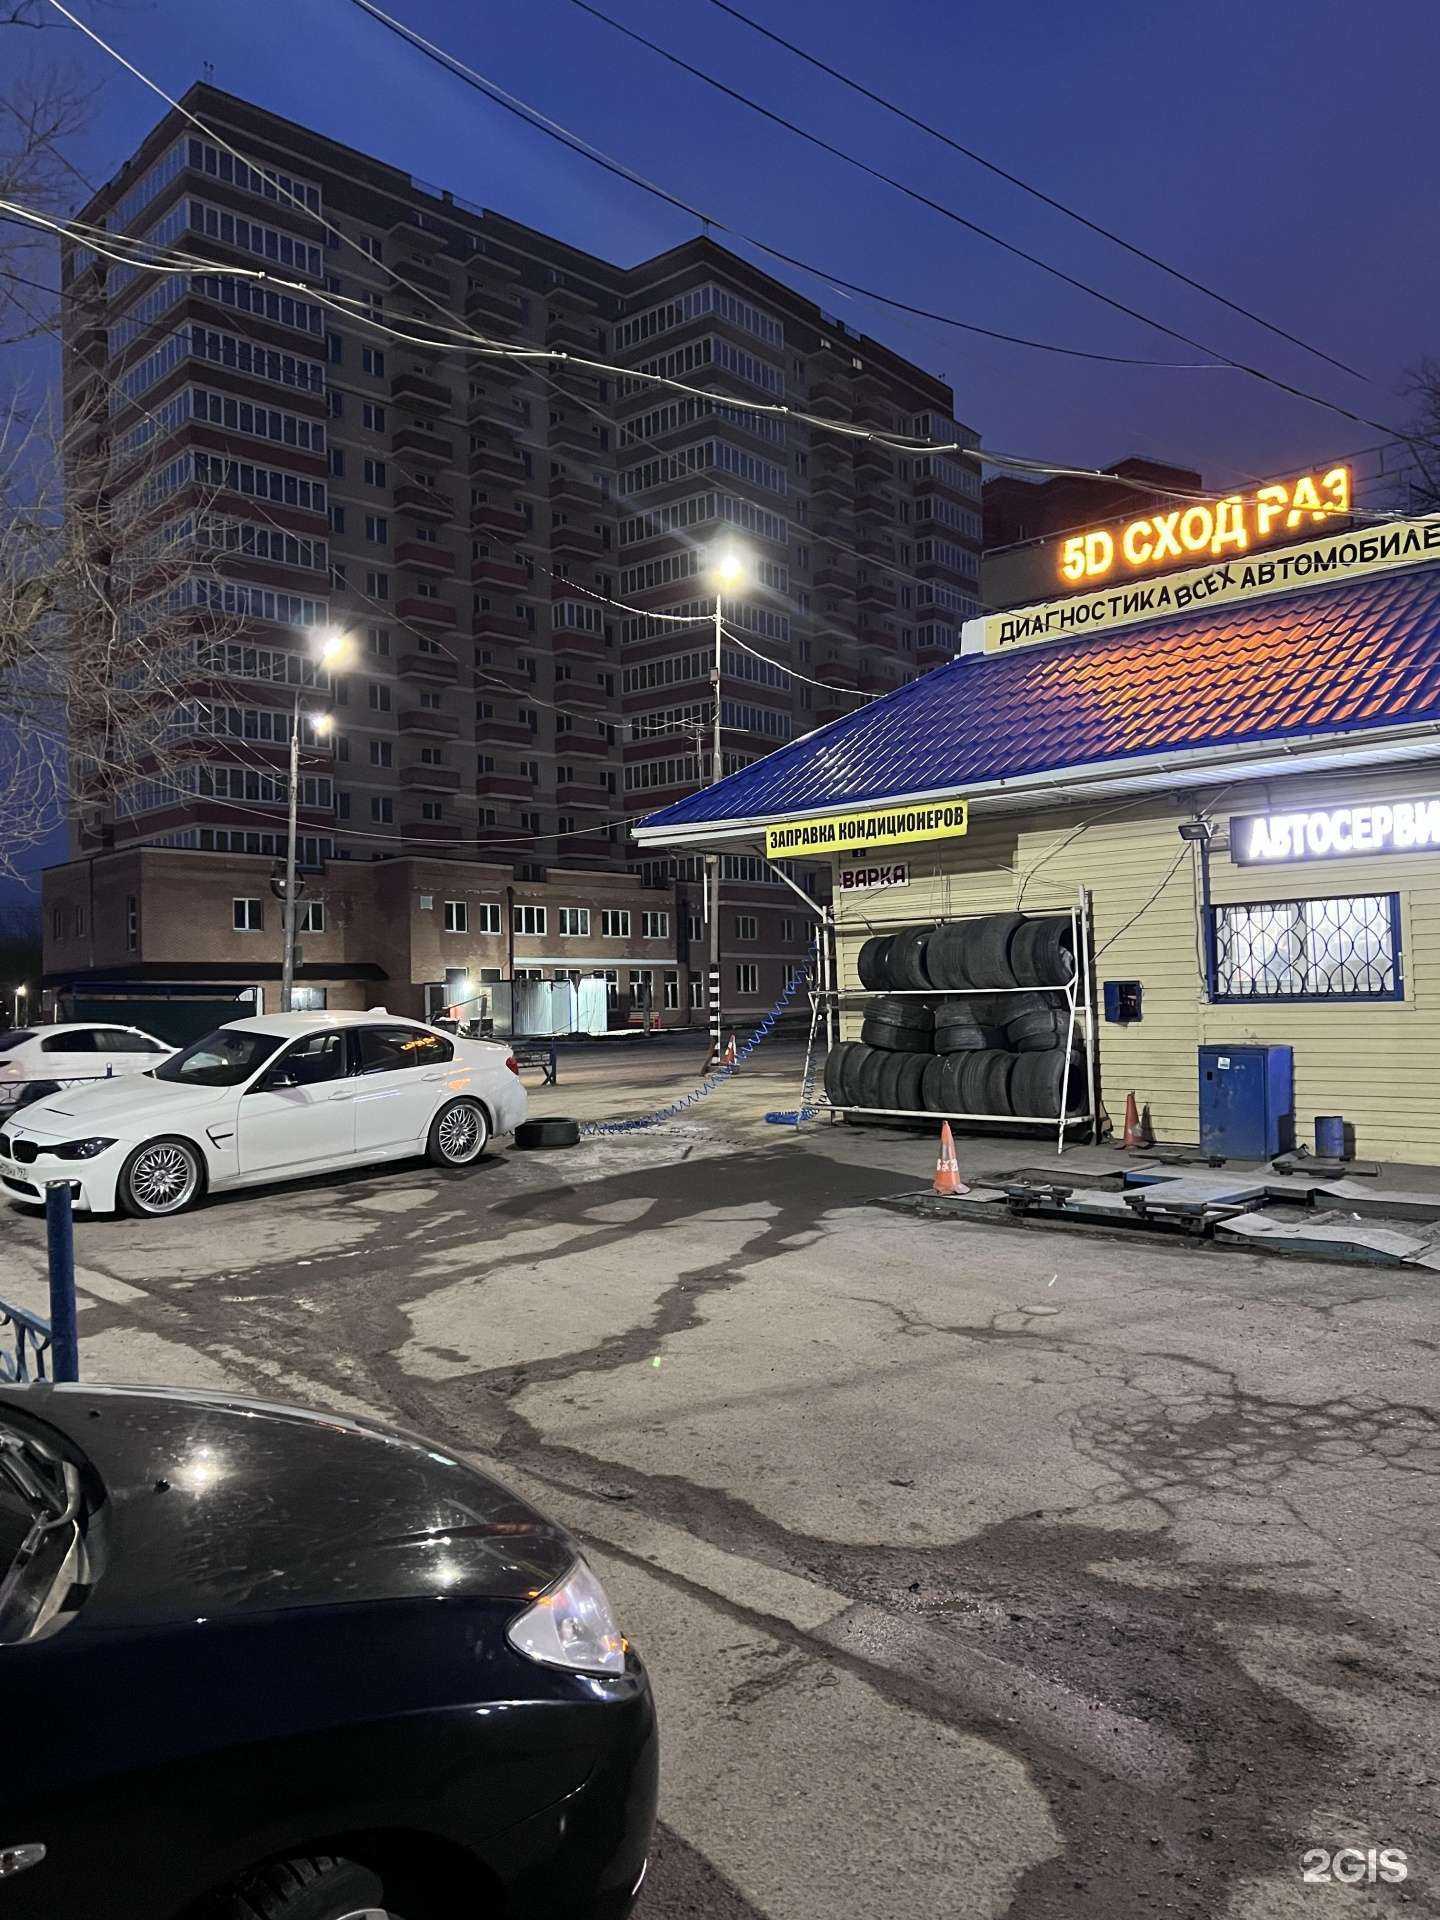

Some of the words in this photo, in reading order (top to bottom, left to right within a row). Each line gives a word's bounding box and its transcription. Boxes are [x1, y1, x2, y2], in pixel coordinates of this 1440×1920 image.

[1062, 530, 1114, 580] 5D
[1123, 496, 1248, 565] СХОД
[1256, 468, 1349, 534] РАЗ
[999, 585, 1171, 645] ДИАГНОСТИКА
[1174, 564, 1237, 609] ВСЕХ
[770, 824, 836, 849] ЗАПРАВКА
[838, 806, 964, 841] КОНДИЦИОНЕРОВ
[1248, 800, 1440, 859] АВТОСЕРВИ
[839, 864, 906, 889] ВАРКА
